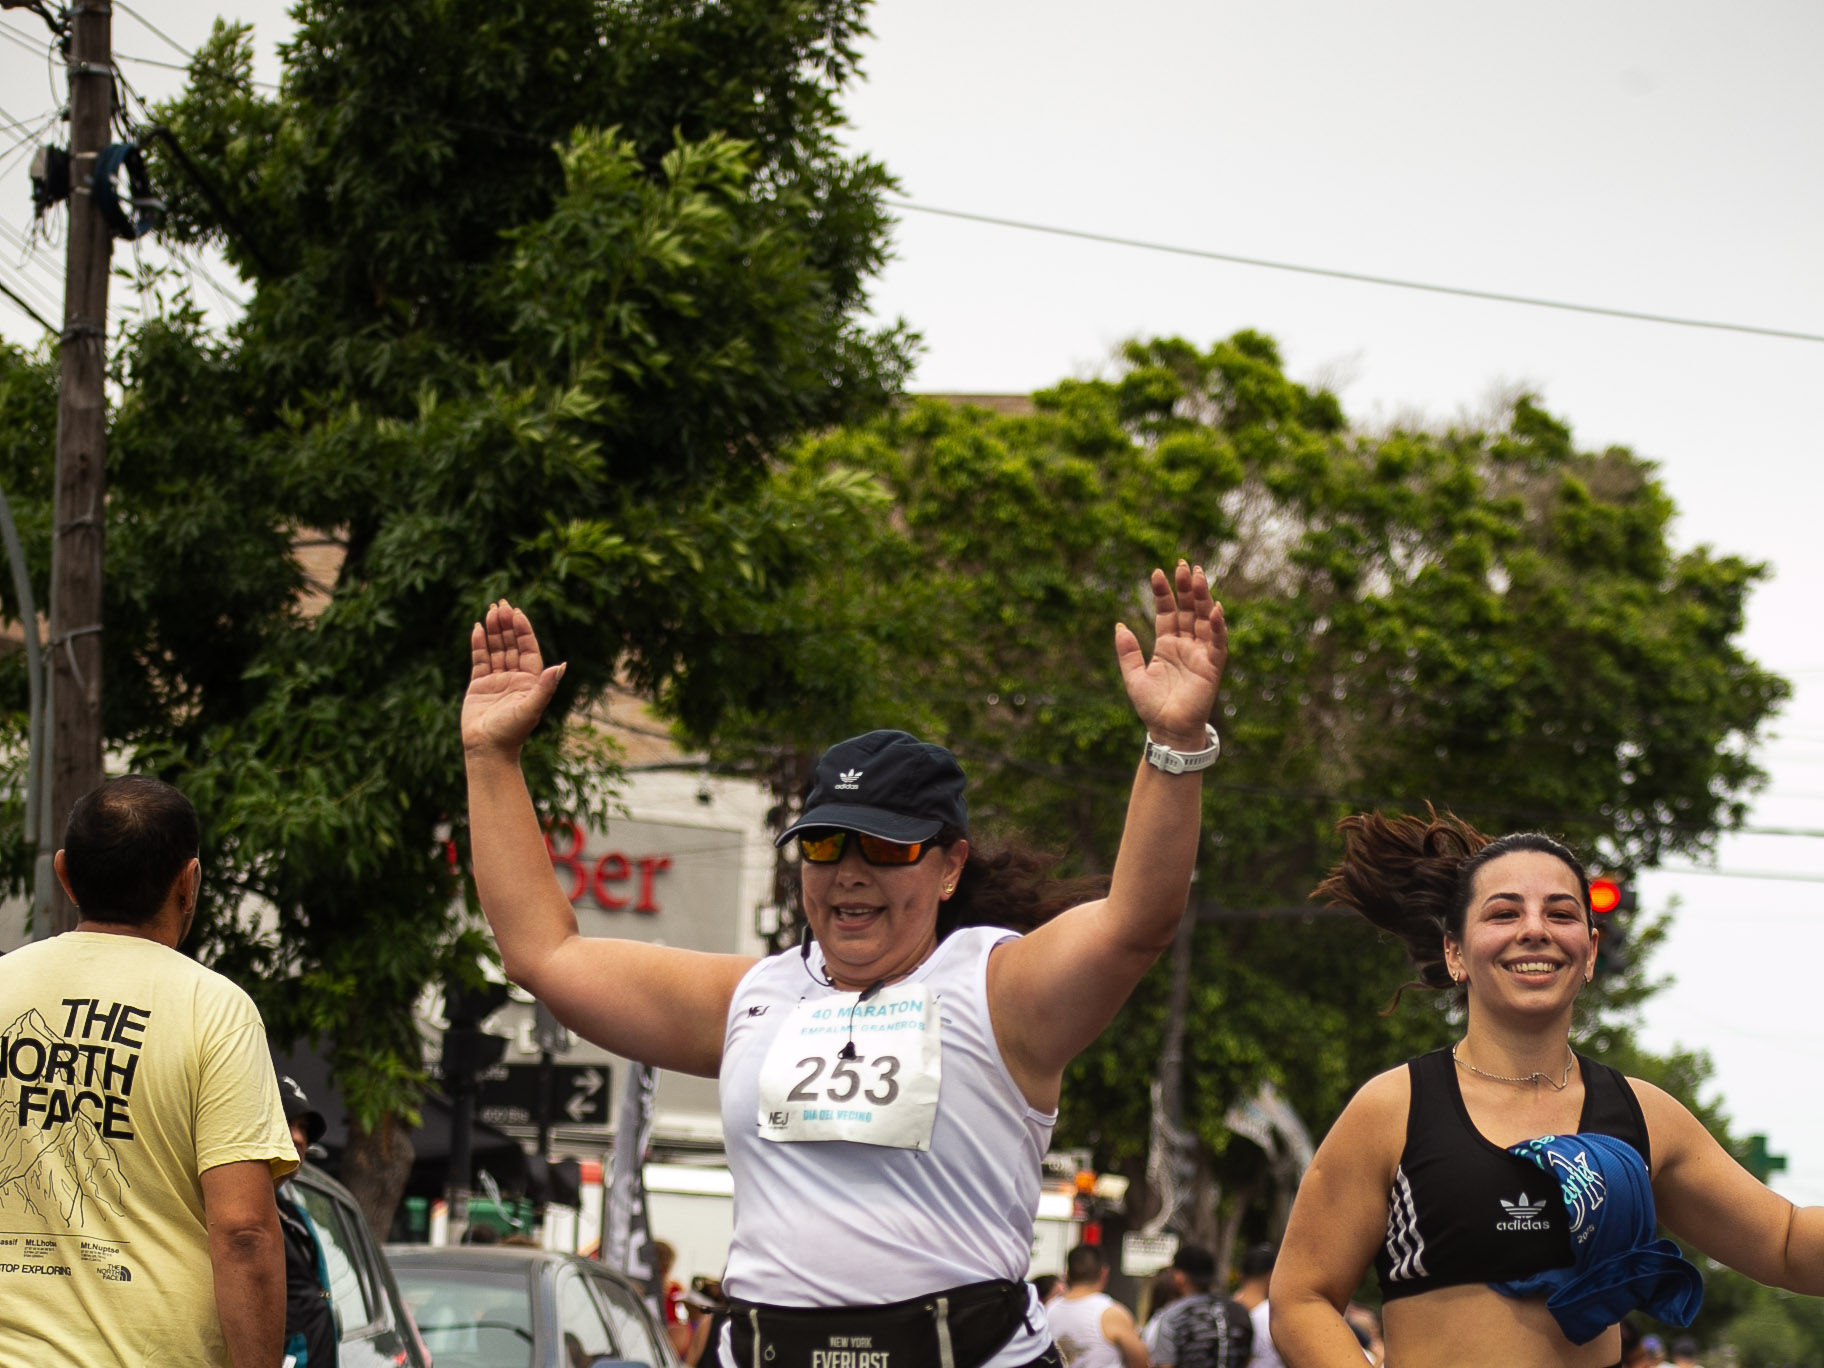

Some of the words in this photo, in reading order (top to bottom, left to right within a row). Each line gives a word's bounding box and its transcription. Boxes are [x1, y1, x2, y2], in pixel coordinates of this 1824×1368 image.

[812, 1008, 832, 1019] 40
[837, 1000, 923, 1018] MARATON
[62, 999, 152, 1050] THE
[861, 1021, 925, 1032] GRANEROS
[0, 1036, 140, 1096] ORTH
[786, 1055, 901, 1106] 253
[19, 1085, 134, 1140] FACE
[769, 1112, 789, 1125] NEJ
[1496, 1219, 1550, 1231] adidas
[96, 1268, 121, 1276] NORTH
[829, 1337, 848, 1348] NEW
[850, 1337, 872, 1348] YORK
